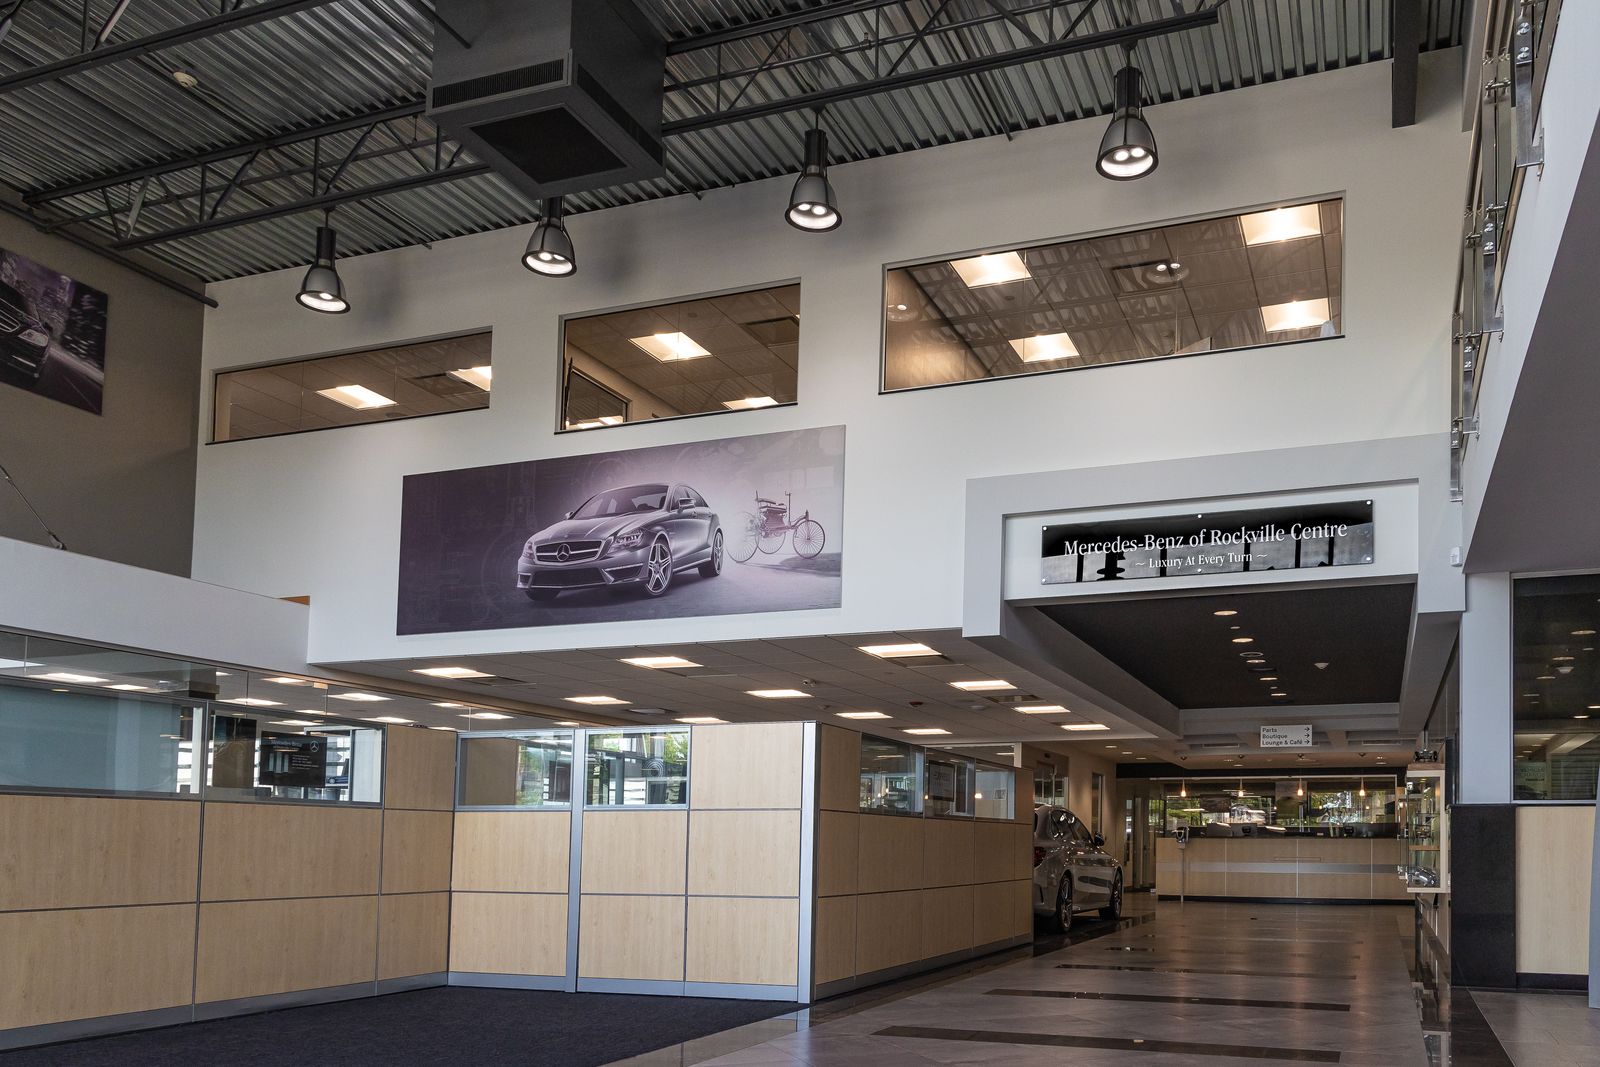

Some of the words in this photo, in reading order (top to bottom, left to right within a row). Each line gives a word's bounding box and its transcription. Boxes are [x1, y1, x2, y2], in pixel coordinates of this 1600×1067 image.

[1064, 534, 1184, 556] Mercedes-Benz
[1189, 529, 1206, 547] of
[1210, 524, 1285, 546] Rockville
[1291, 523, 1348, 541] Centre
[1149, 557, 1183, 570] Luxury
[1185, 555, 1195, 566] At
[1198, 554, 1225, 566] Every
[1228, 551, 1253, 563] Turn
